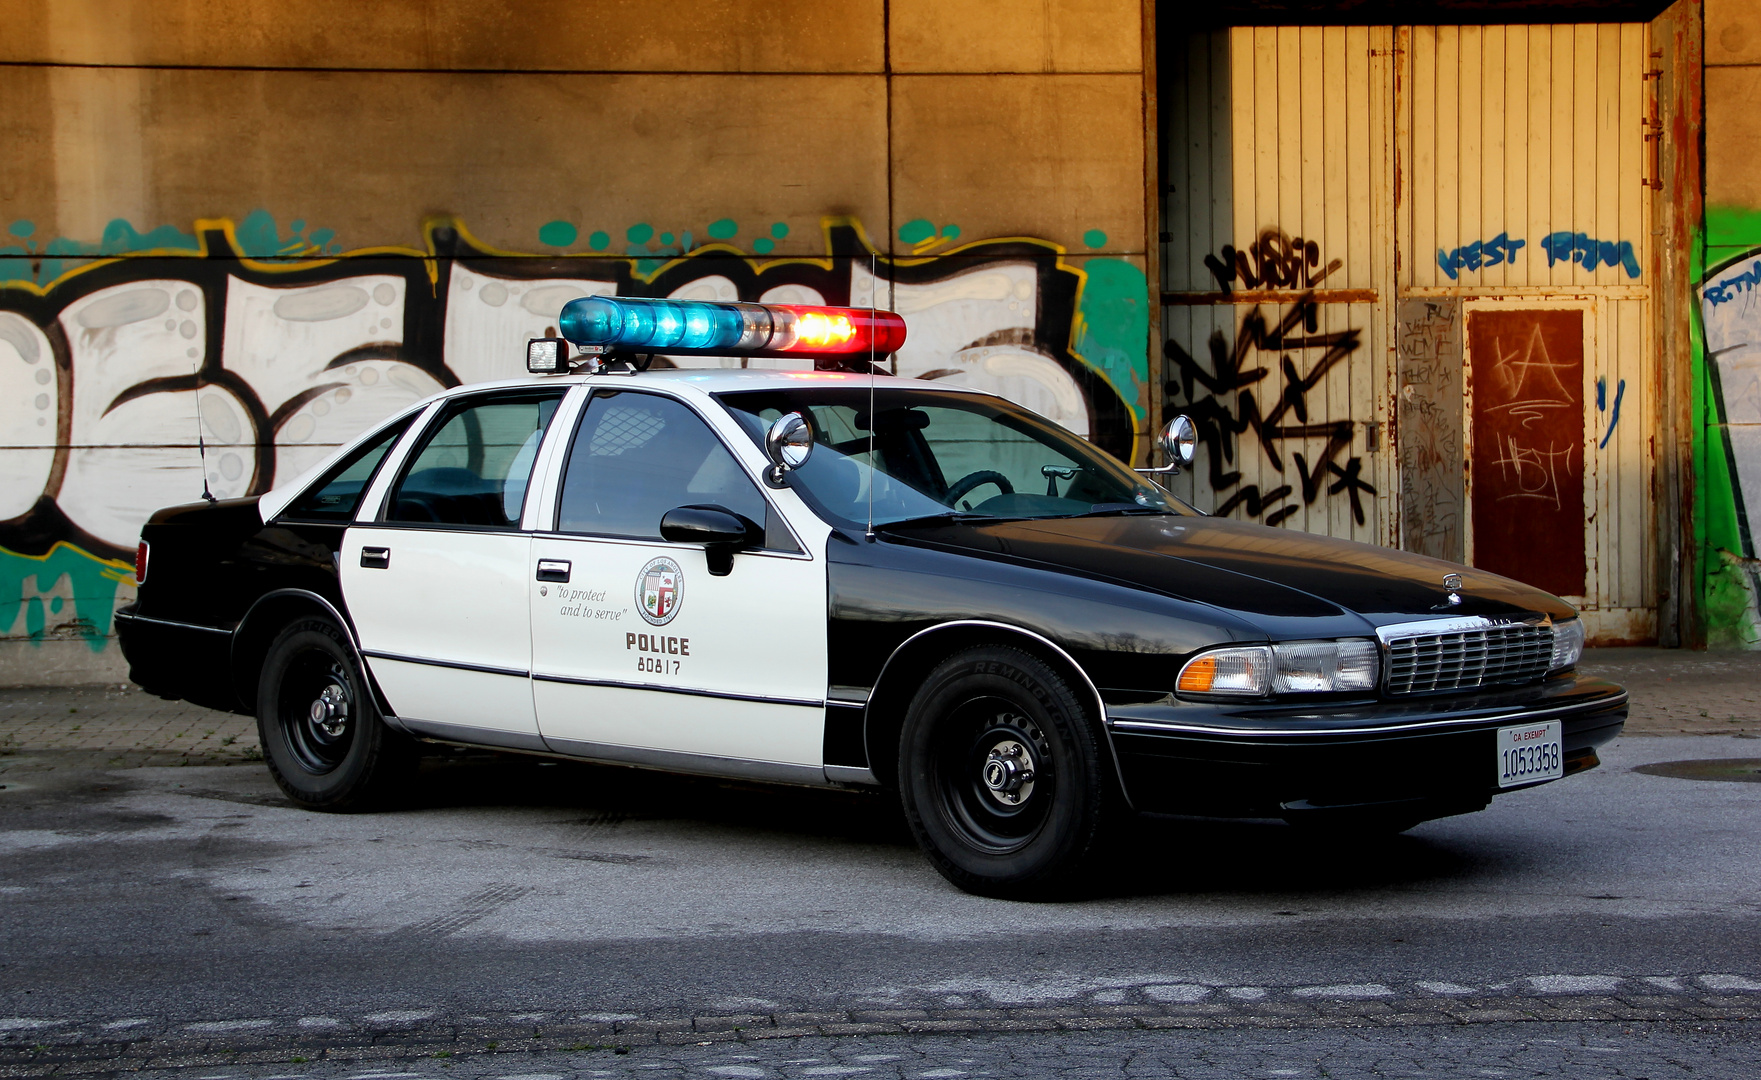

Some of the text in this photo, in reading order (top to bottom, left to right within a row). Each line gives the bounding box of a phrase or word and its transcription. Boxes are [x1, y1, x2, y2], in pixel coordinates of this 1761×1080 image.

[569, 589, 606, 602] protect
[560, 603, 581, 617] and
[582, 605, 593, 618] to
[626, 632, 690, 656] POLICE
[638, 656, 681, 675] 80817
[1513, 729, 1547, 742] CA EXEMPT
[1503, 742, 1559, 778] 1053358
